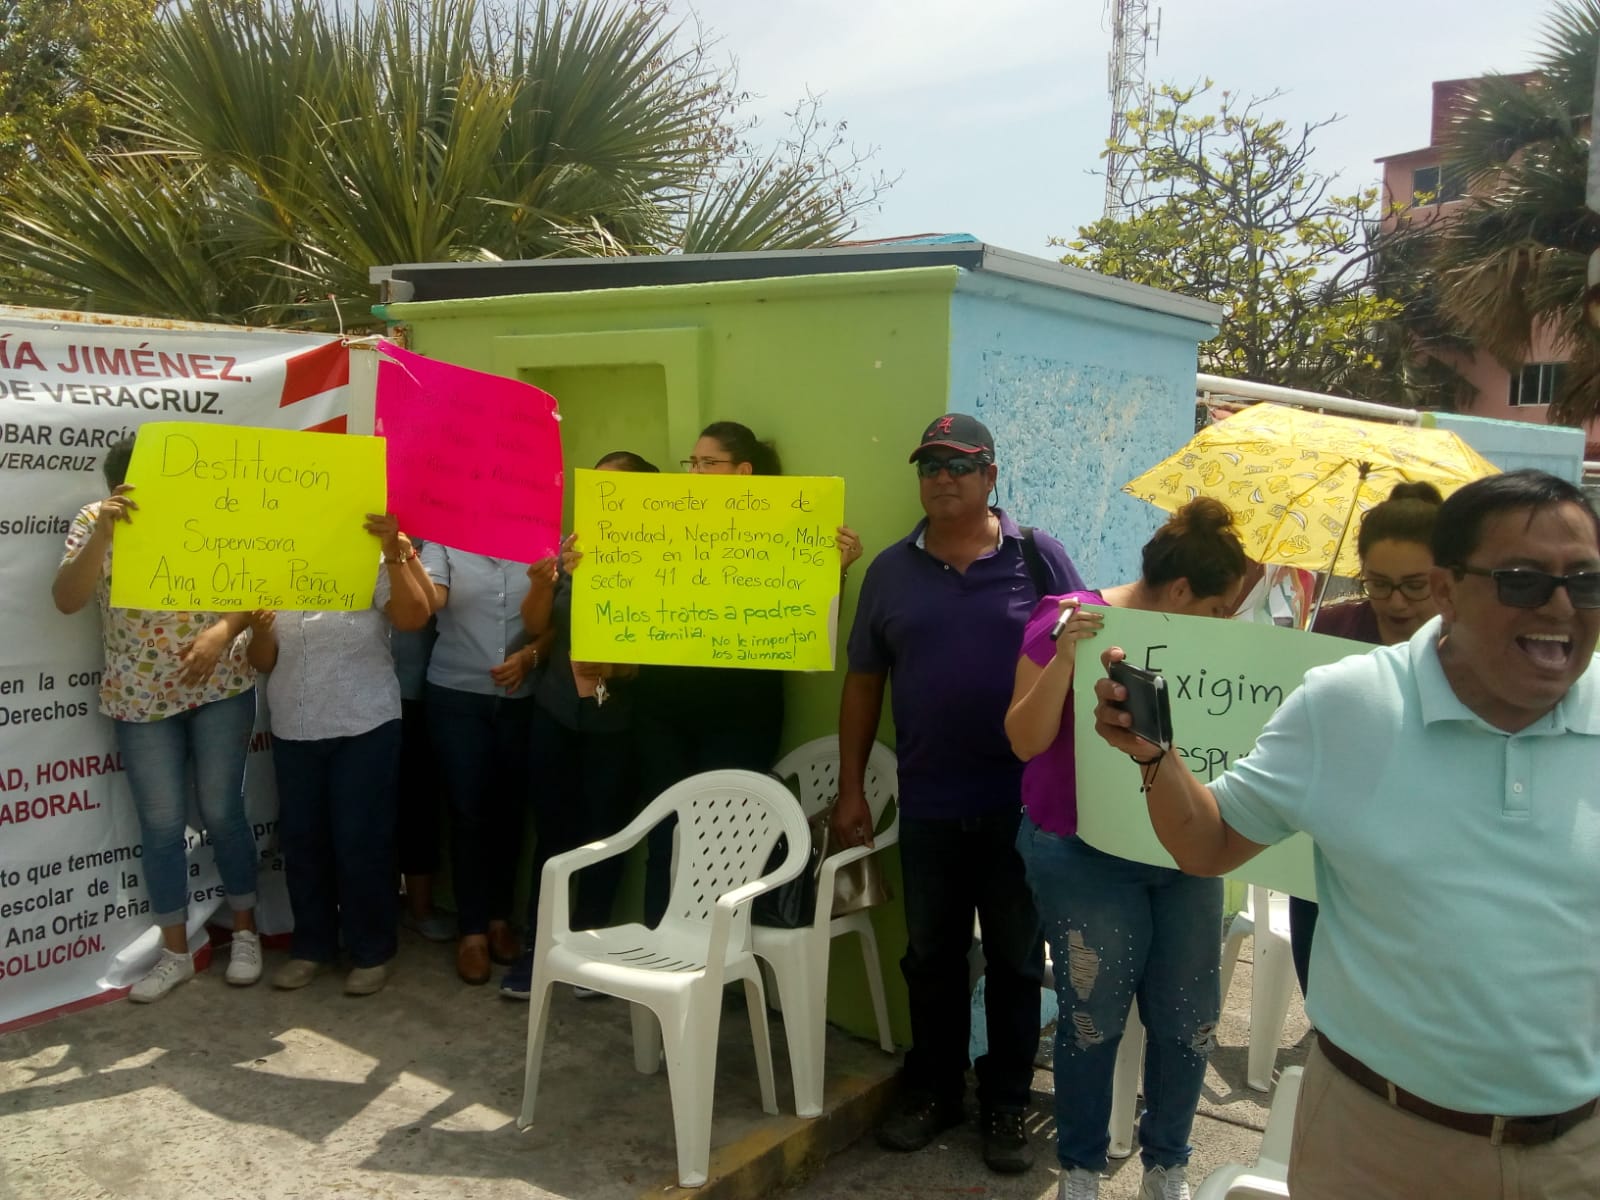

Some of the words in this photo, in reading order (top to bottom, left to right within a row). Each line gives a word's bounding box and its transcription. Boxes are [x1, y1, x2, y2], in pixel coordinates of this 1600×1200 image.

[57, 342, 252, 383] JIMÉNEZ.
[40, 382, 224, 415] VERACRUZ.
[0, 423, 52, 445] BAR
[59, 426, 136, 448] GARCÍ
[160, 433, 330, 491] Destitución
[214, 487, 240, 513] de
[262, 487, 279, 510] la
[595, 480, 625, 512] Por
[642, 489, 709, 512] cometer
[725, 488, 771, 511] actos
[791, 490, 814, 513] de
[183, 518, 296, 560] Supervisora
[685, 516, 790, 548] Nepotismo,
[795, 525, 835, 549] Malos
[589, 545, 642, 566] tratos
[663, 551, 682, 563] en
[694, 545, 711, 562] la
[721, 547, 770, 562] zona
[792, 546, 826, 567] 156
[149, 555, 196, 592] Ana
[211, 557, 268, 594] Ortiz
[287, 558, 339, 595] Peña
[590, 570, 635, 590] sector
[654, 566, 677, 588] 41
[691, 570, 711, 587] de
[721, 566, 807, 591] Preescolar
[160, 594, 178, 606] de
[190, 593, 201, 606] la
[211, 597, 243, 607] zona
[257, 594, 284, 607] 156
[596, 599, 651, 625] Malos
[655, 598, 720, 625] tratos
[724, 606, 738, 622] a
[743, 600, 817, 626] padres
[614, 626, 637, 644] de
[648, 625, 707, 642] familia.
[711, 636, 731, 647] No
[751, 628, 818, 650] importan
[712, 649, 733, 660] los
[736, 646, 797, 664] alumnos!
[1, 678, 25, 695] en
[38, 672, 55, 691] la
[27, 861, 62, 886] que
[87, 878, 109, 898] de
[121, 872, 138, 890] la
[5, 927, 46, 949] Ana
[52, 910, 98, 936] Ortiz
[104, 898, 150, 923] Peña
